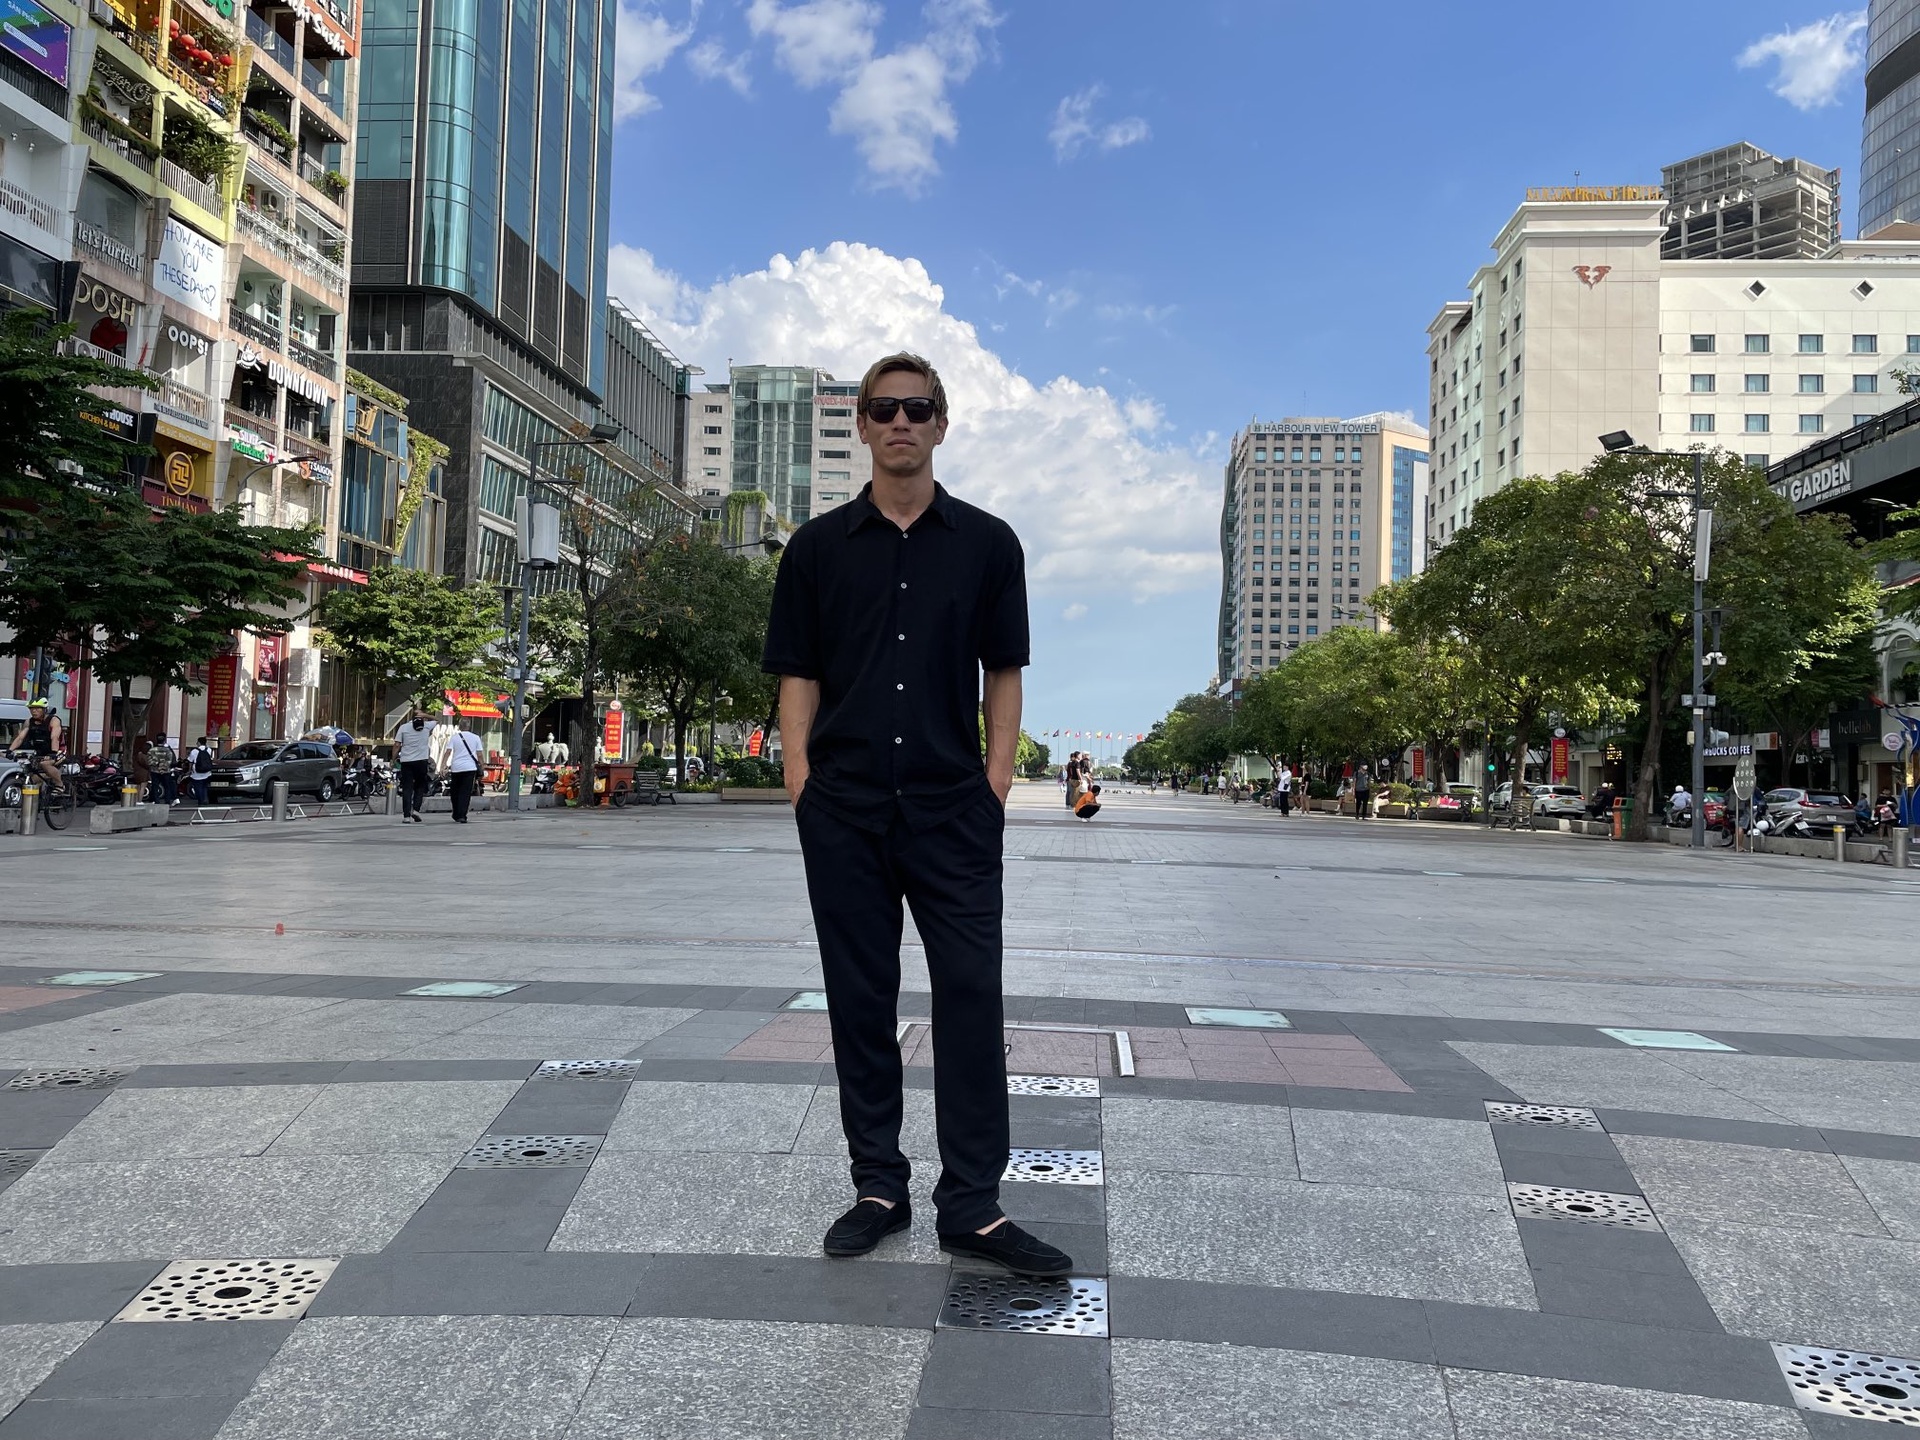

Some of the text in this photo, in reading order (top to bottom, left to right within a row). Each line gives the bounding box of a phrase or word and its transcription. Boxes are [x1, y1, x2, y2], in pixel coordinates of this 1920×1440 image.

[312, 12, 346, 57] Sushi
[165, 220, 214, 263] HOW ARE
[180, 248, 200, 273] YOU
[168, 325, 209, 356] OOPS!
[268, 360, 329, 408] DOWNTOWN
[1264, 424, 1311, 433] HARBOUR
[1314, 424, 1339, 432] VIEW
[1342, 424, 1377, 433] TOWER
[1790, 459, 1851, 503] GARDEN
